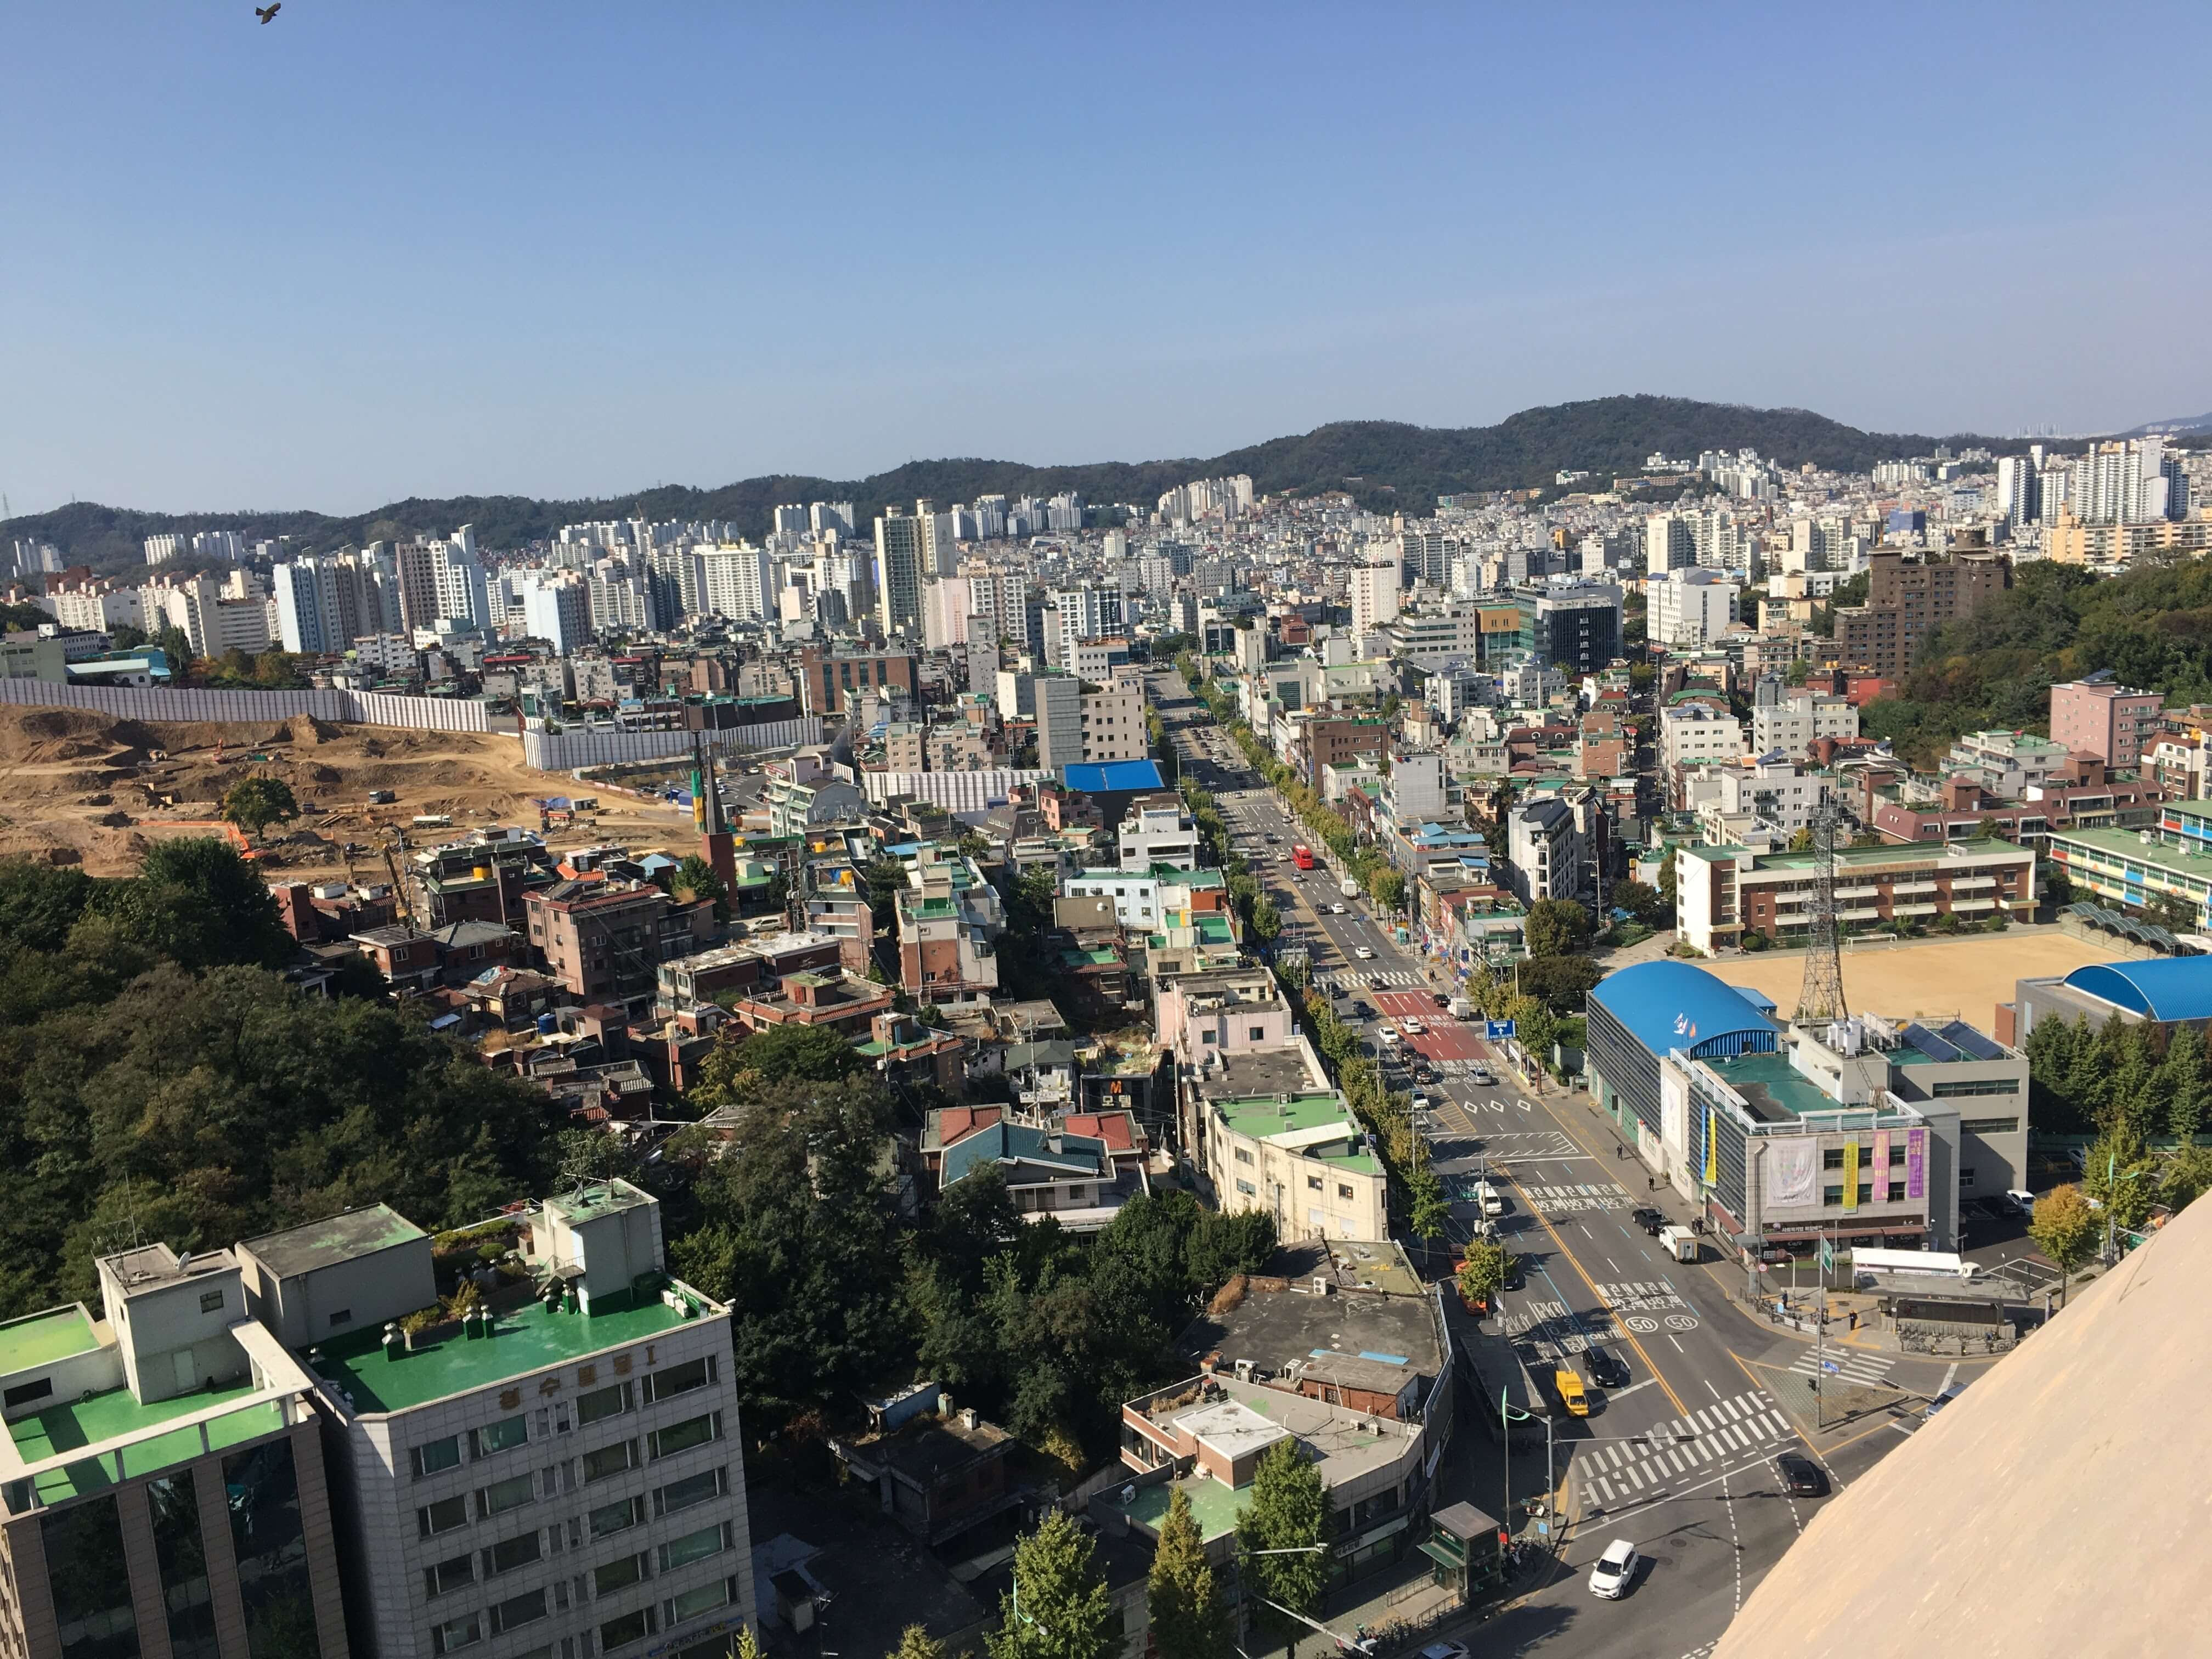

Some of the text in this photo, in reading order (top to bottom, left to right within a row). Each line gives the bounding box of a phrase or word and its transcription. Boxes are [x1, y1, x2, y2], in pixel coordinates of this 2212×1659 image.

[1110, 1081, 1122, 1093] M
[1102, 1094, 1131, 1108] 모텔
[1630, 1319, 1653, 1330] 50
[1669, 1318, 1692, 1328] 50
